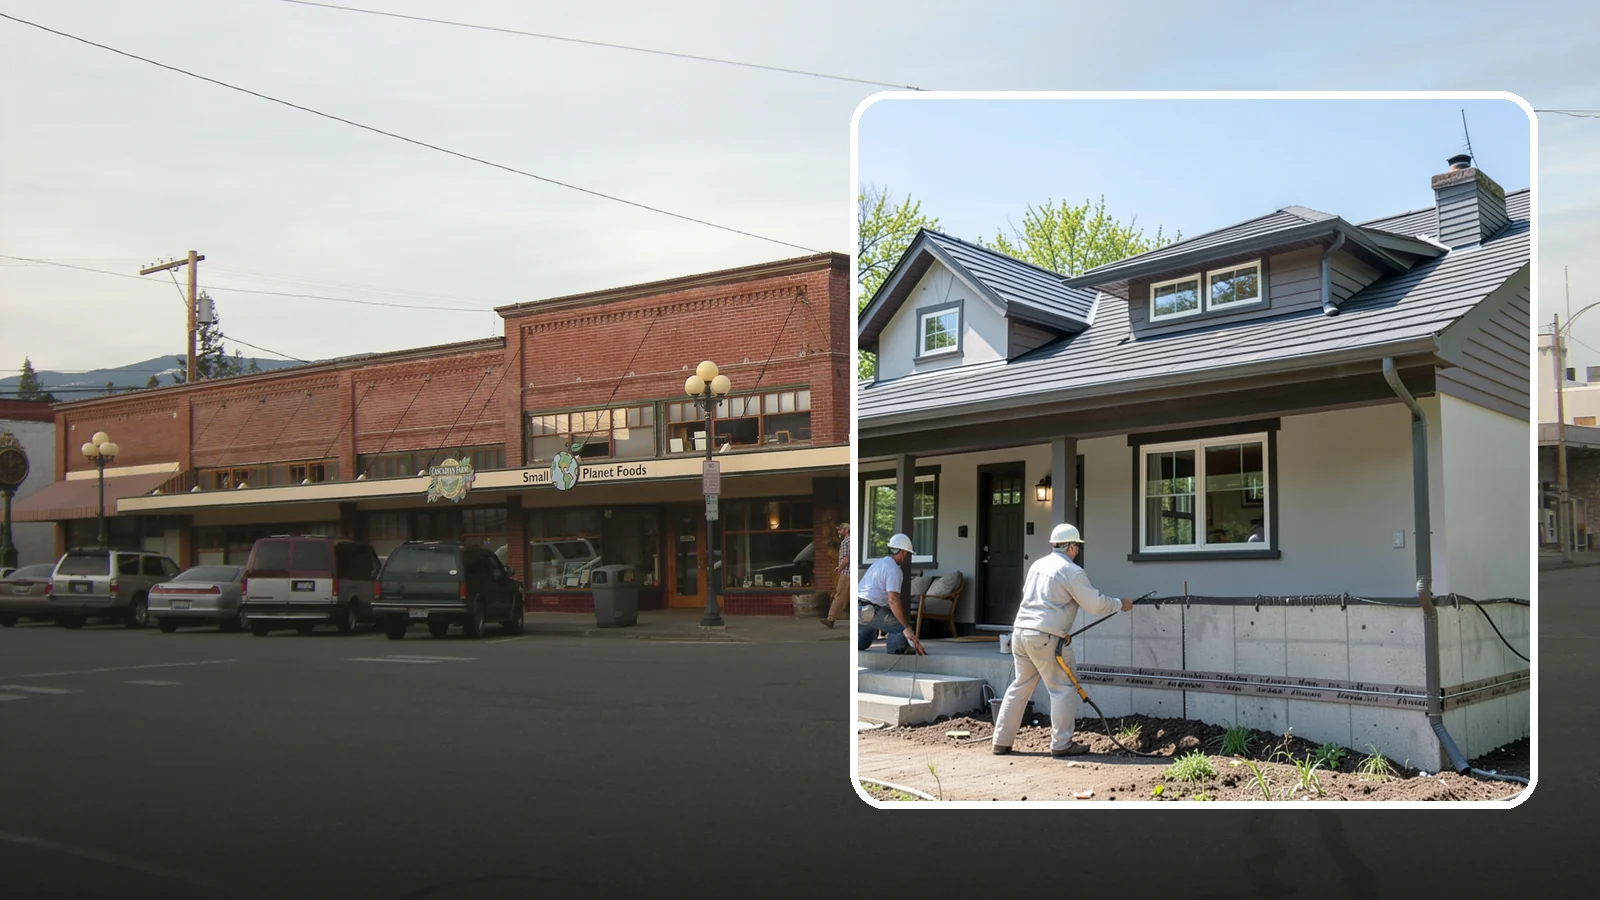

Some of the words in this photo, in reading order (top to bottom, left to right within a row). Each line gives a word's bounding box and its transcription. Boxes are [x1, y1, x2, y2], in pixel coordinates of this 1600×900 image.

[523, 471, 549, 483] Small
[583, 468, 614, 479] Planet
[617, 464, 647, 477] Foods
